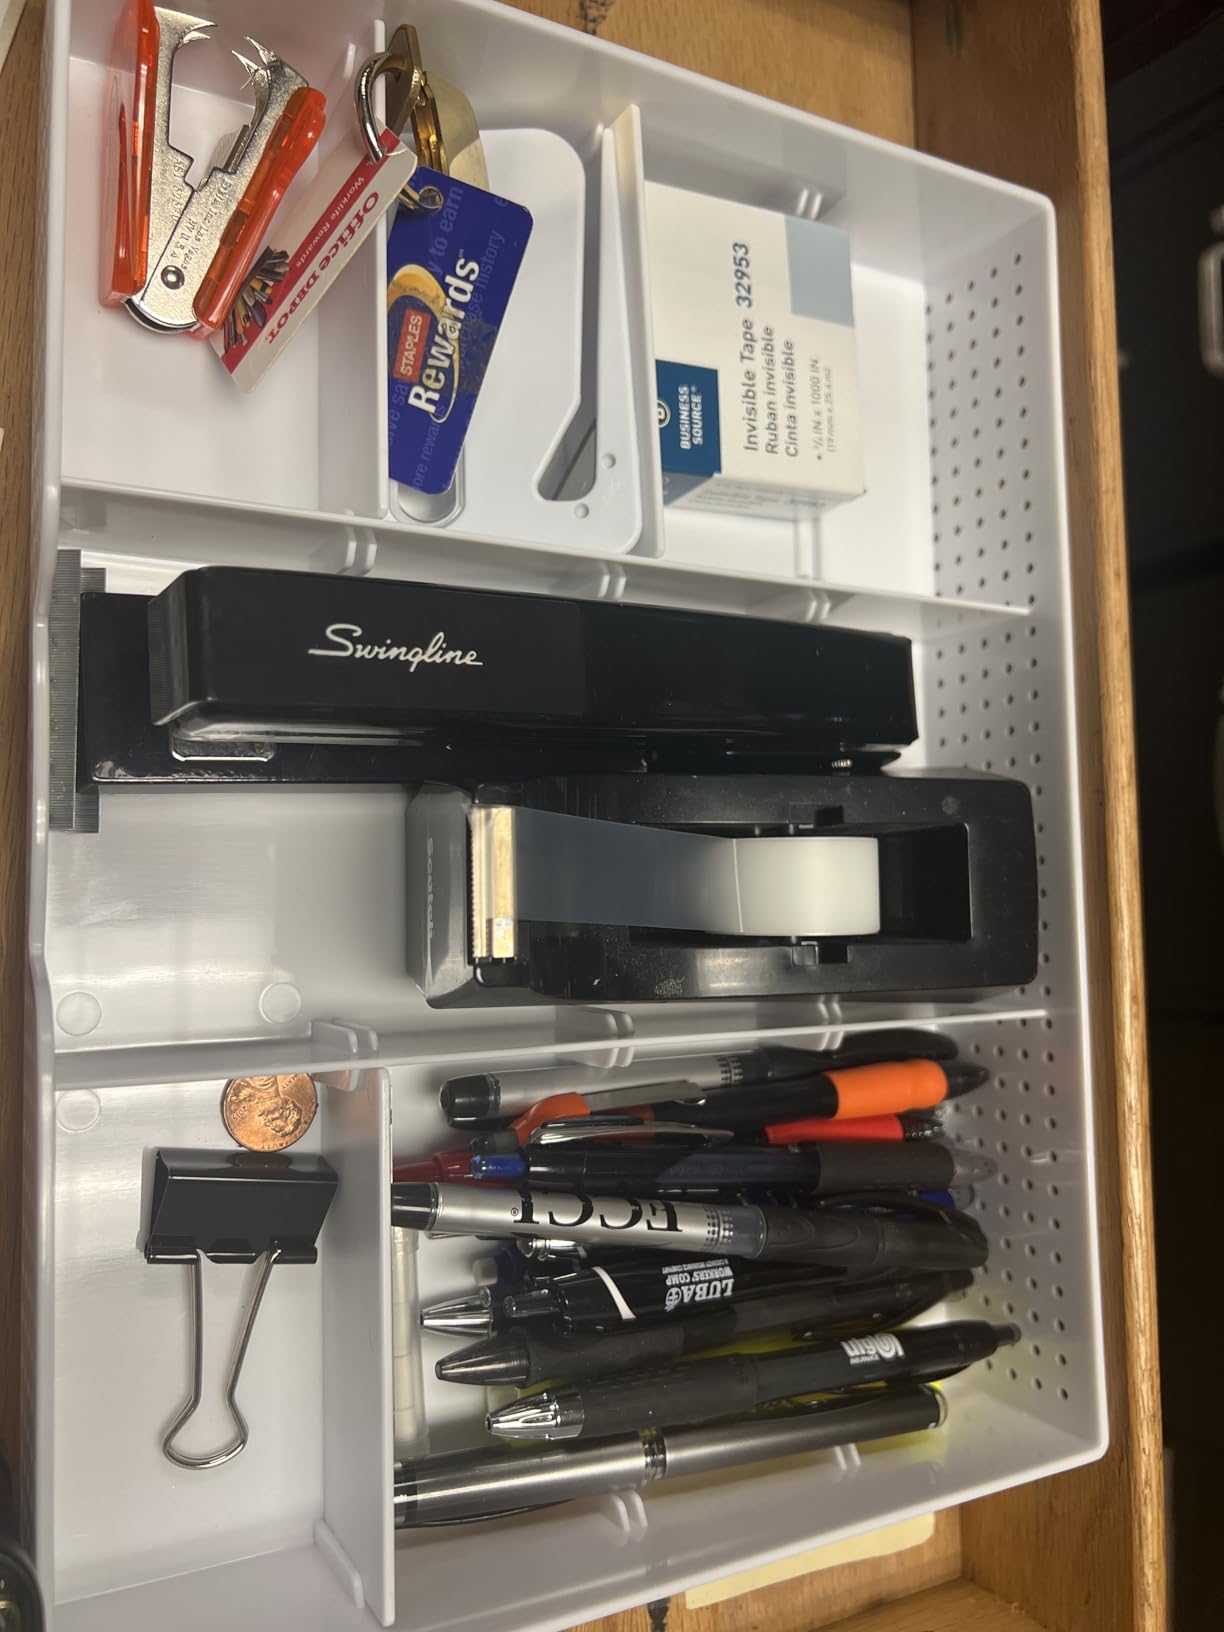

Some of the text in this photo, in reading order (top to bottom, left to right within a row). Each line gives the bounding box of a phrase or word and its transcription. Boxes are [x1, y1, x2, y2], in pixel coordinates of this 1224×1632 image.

[295, 177, 365, 268] Worklife Rewards
[319, 191, 380, 272] Office
[439, 185, 464, 233] earn
[473, 229, 505, 290] history
[399, 313, 423, 378] STAPLES
[407, 255, 480, 415] Rewards
[732, 241, 758, 452] Invisible Tape 32953
[678, 383, 692, 450] BUSINESS
[763, 326, 779, 454] Ruban invisible
[781, 338, 800, 458] Cinta invisible
[307, 623, 484, 672] Swingline
[666, 1272, 691, 1286] COMP
[681, 1279, 735, 1303] LUBA
